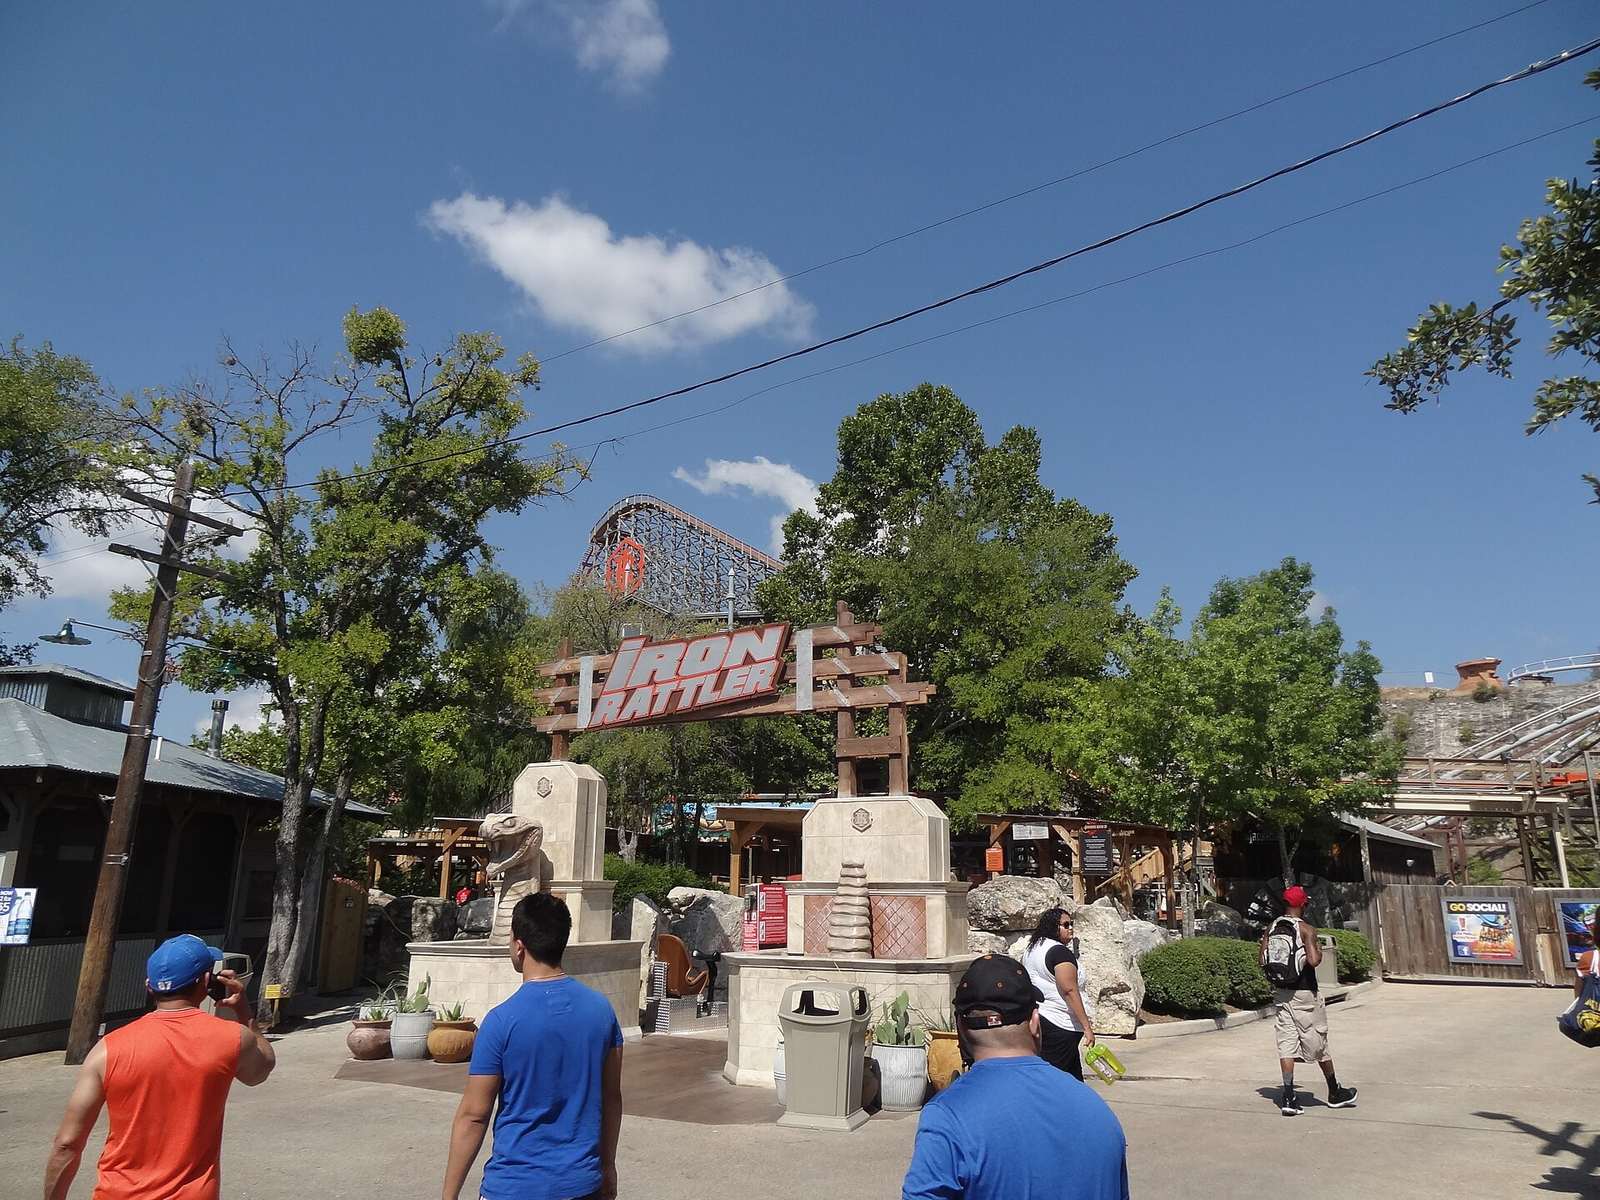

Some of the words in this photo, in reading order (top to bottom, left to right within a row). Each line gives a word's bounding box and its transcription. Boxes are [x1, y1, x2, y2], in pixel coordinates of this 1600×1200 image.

[589, 658, 779, 729] RATTLER
[1450, 903, 1466, 911] GO
[1466, 903, 1507, 912] SOCIAL!
